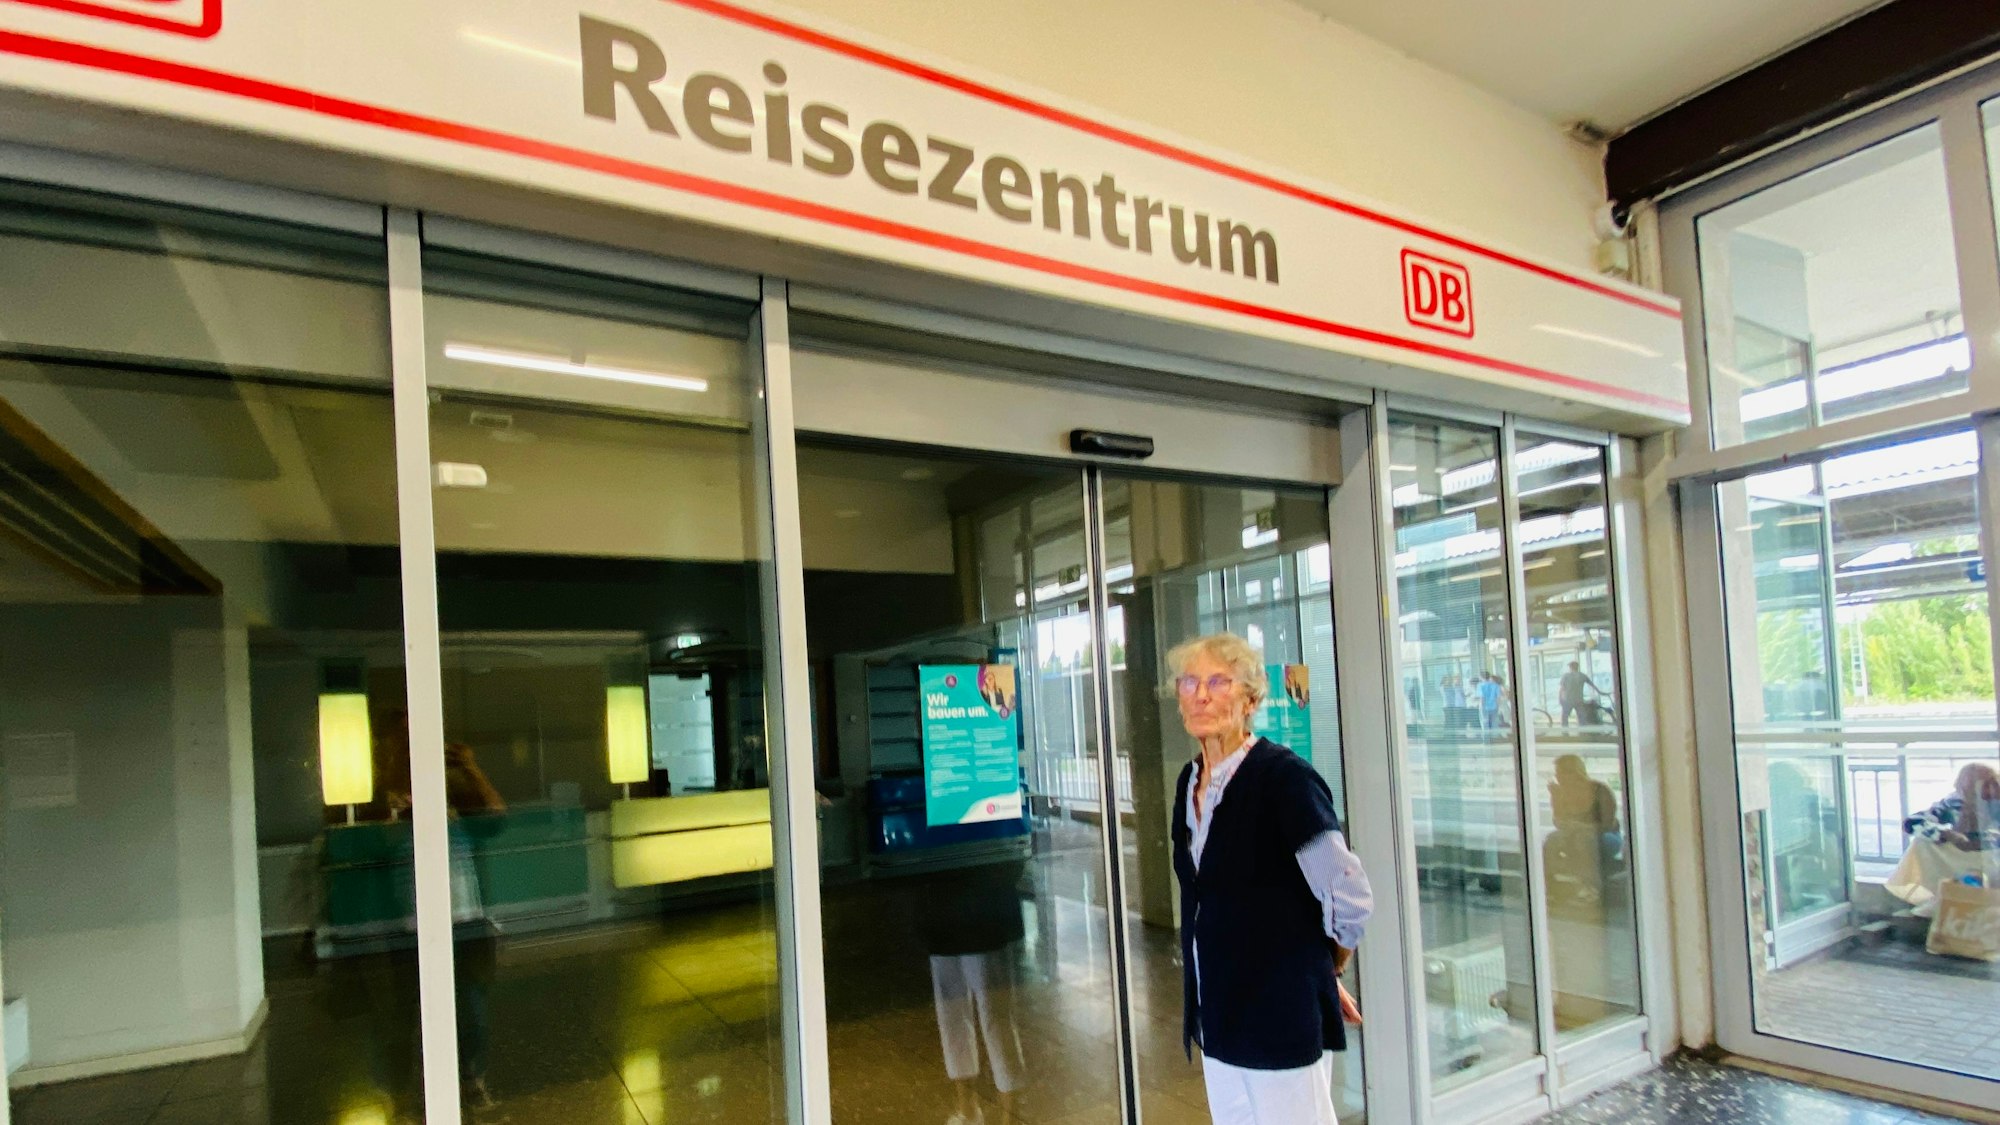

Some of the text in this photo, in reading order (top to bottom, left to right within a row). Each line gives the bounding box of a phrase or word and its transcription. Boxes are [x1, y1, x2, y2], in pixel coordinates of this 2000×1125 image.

[579, 14, 1279, 285] Reisezentrum
[1411, 263, 1465, 323] DB
[927, 692, 949, 706] Wir
[928, 706, 966, 720] bauen
